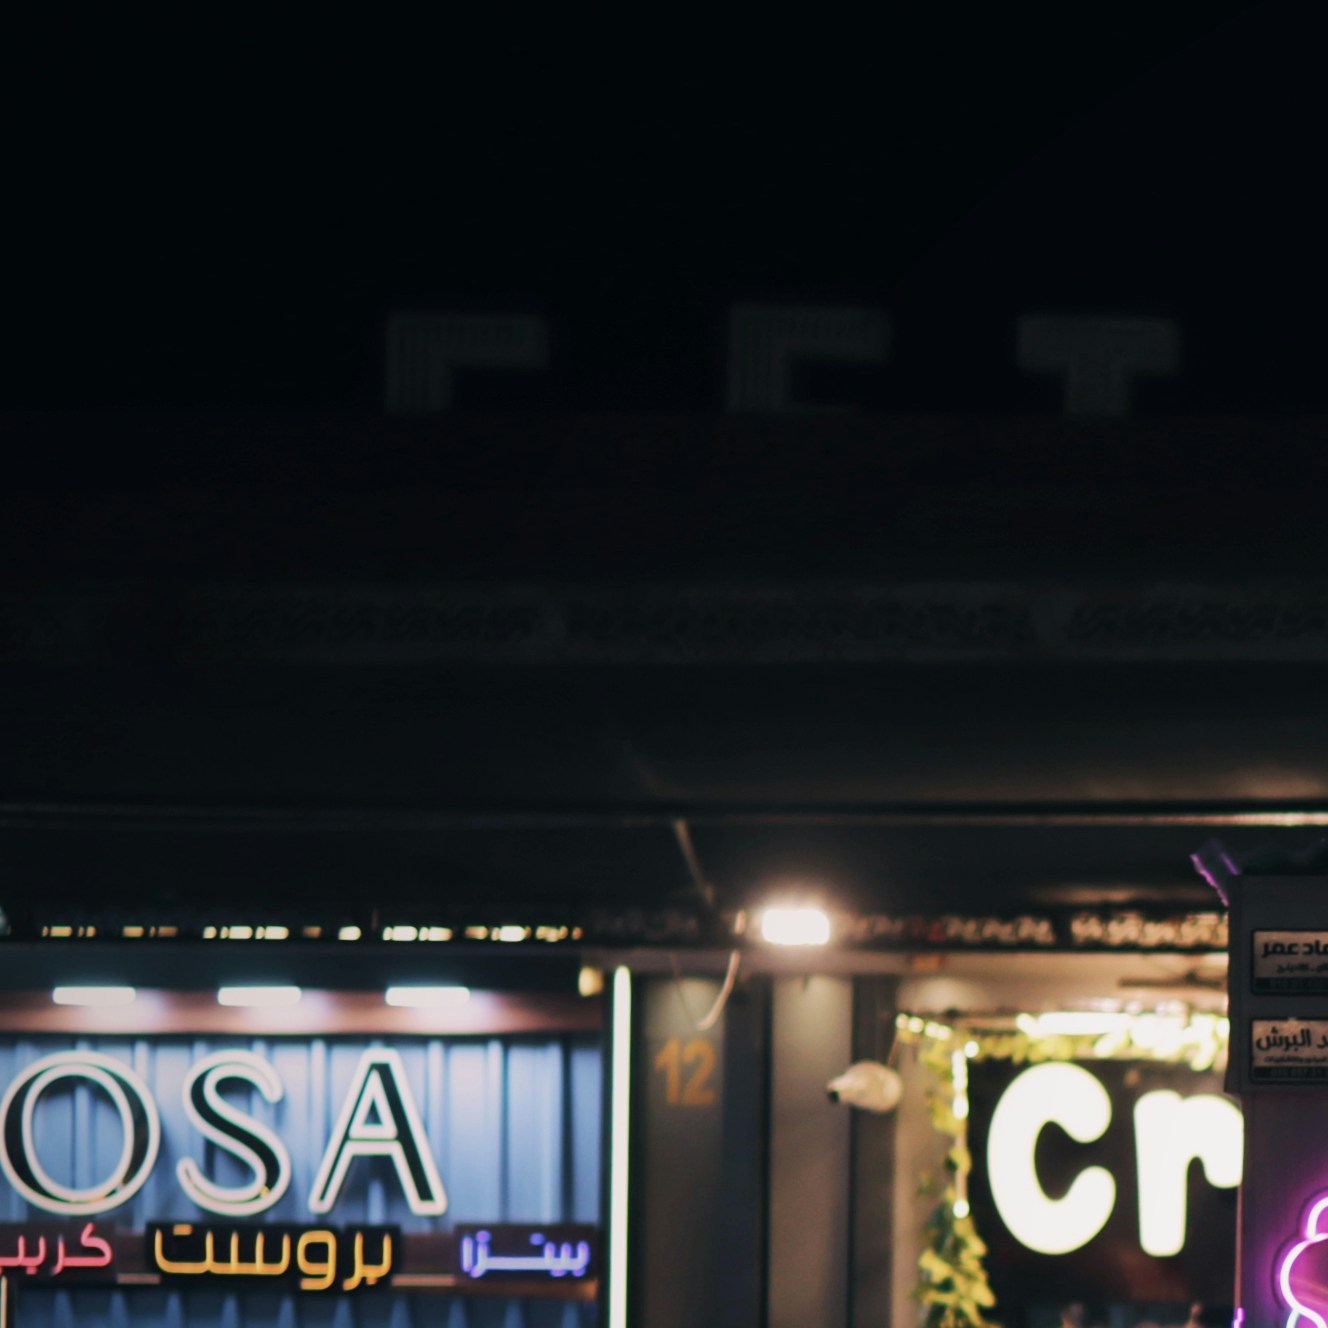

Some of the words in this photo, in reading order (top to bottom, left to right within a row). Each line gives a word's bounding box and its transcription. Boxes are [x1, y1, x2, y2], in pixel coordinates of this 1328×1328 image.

[1261, 943, 1298, 958] عمر
[1255, 1026, 1312, 1051] البرش
[653, 1039, 716, 1104] 12
[0, 1047, 448, 1217] OSA
[155, 1224, 393, 1291] بروست
[460, 1230, 591, 1278] بيتزا
